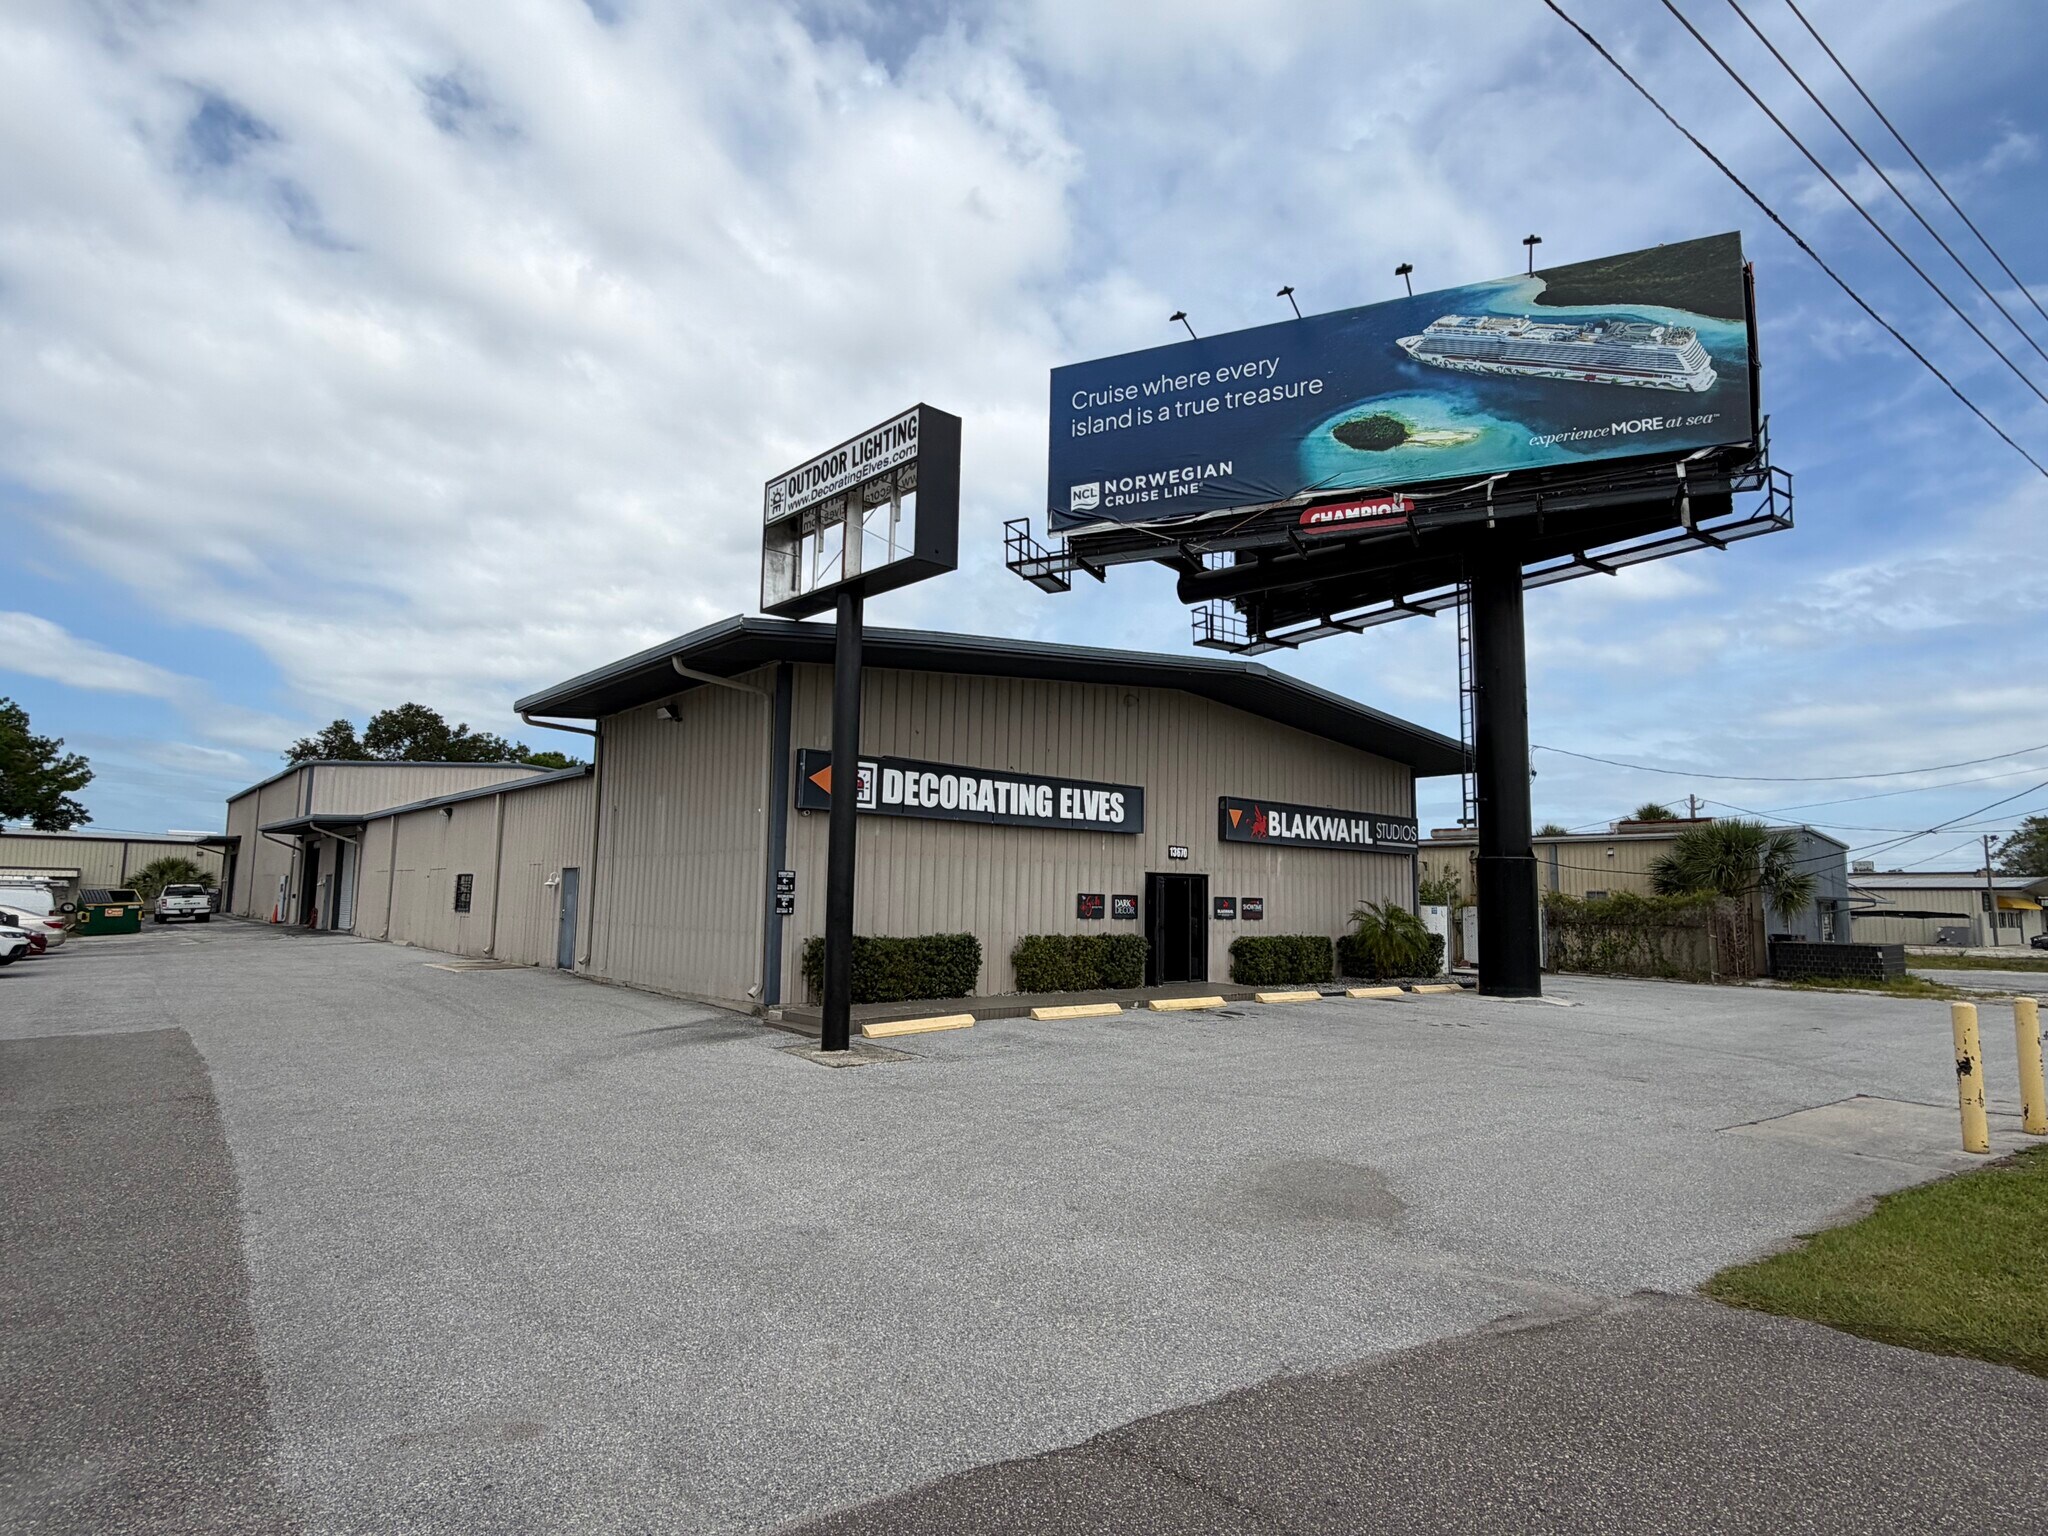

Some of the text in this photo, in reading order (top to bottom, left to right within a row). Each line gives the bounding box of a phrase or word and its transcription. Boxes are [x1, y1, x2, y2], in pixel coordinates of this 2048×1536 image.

[1071, 357, 1280, 410] Cruise where every
[1071, 378, 1324, 438] island is a true treasure
[1529, 427, 1610, 448] experience
[1611, 417, 1664, 436] MORE
[1665, 416, 1683, 429] at
[788, 415, 918, 499] OUTDOOR LIGHTING
[786, 443, 917, 512] www.DecoratingElves.com
[1073, 488, 1098, 501] NCL
[1104, 461, 1233, 494] NORWEGIAN
[1104, 490, 1159, 507] CRUISE
[881, 768, 1125, 824] DECORATING ELVES
[1268, 810, 1417, 845] BLAKWAHL STUDIOS
[1114, 898, 1132, 908] DARK
[1114, 906, 1136, 915] DECOR
